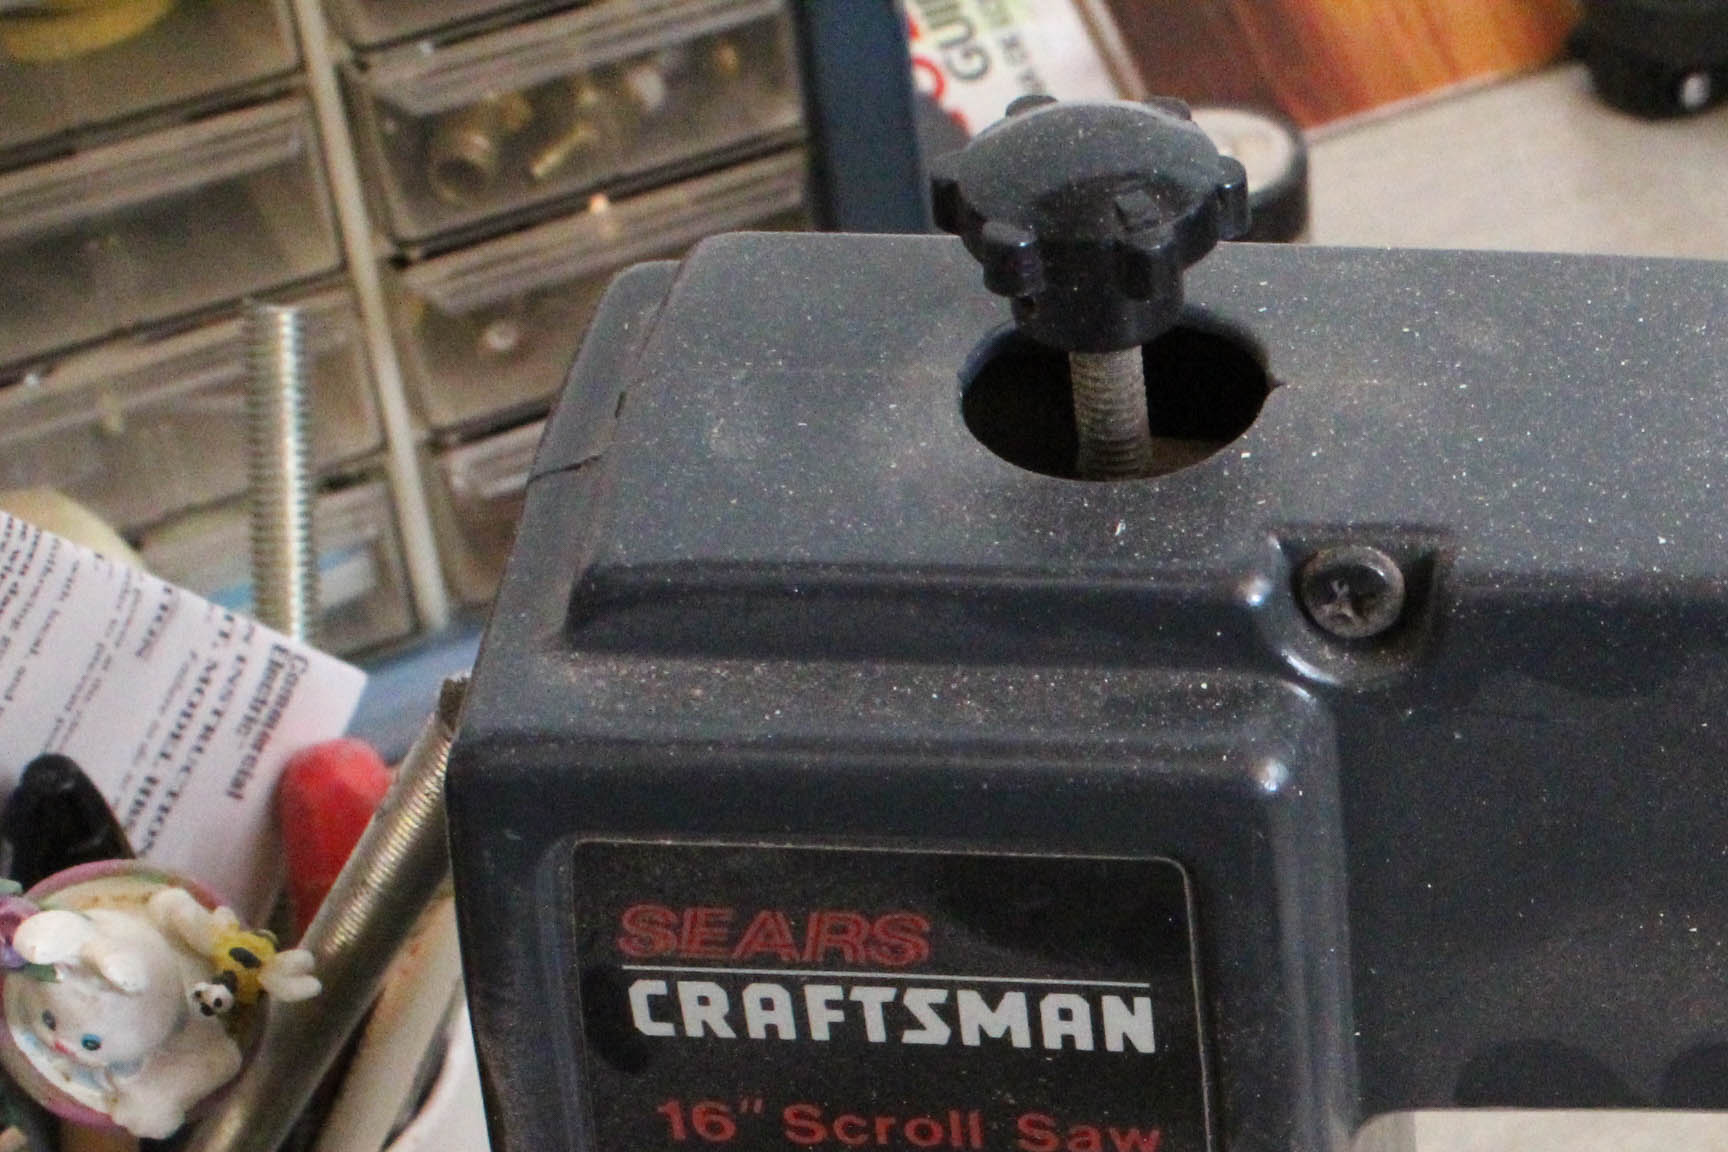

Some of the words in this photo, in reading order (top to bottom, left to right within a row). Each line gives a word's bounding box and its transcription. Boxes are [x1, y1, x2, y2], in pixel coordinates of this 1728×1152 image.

[616, 902, 932, 966] SEARS
[627, 977, 1156, 1055] CRAFTSMAN
[658, 1093, 764, 1144] 16"
[782, 1101, 986, 1151] Scroll
